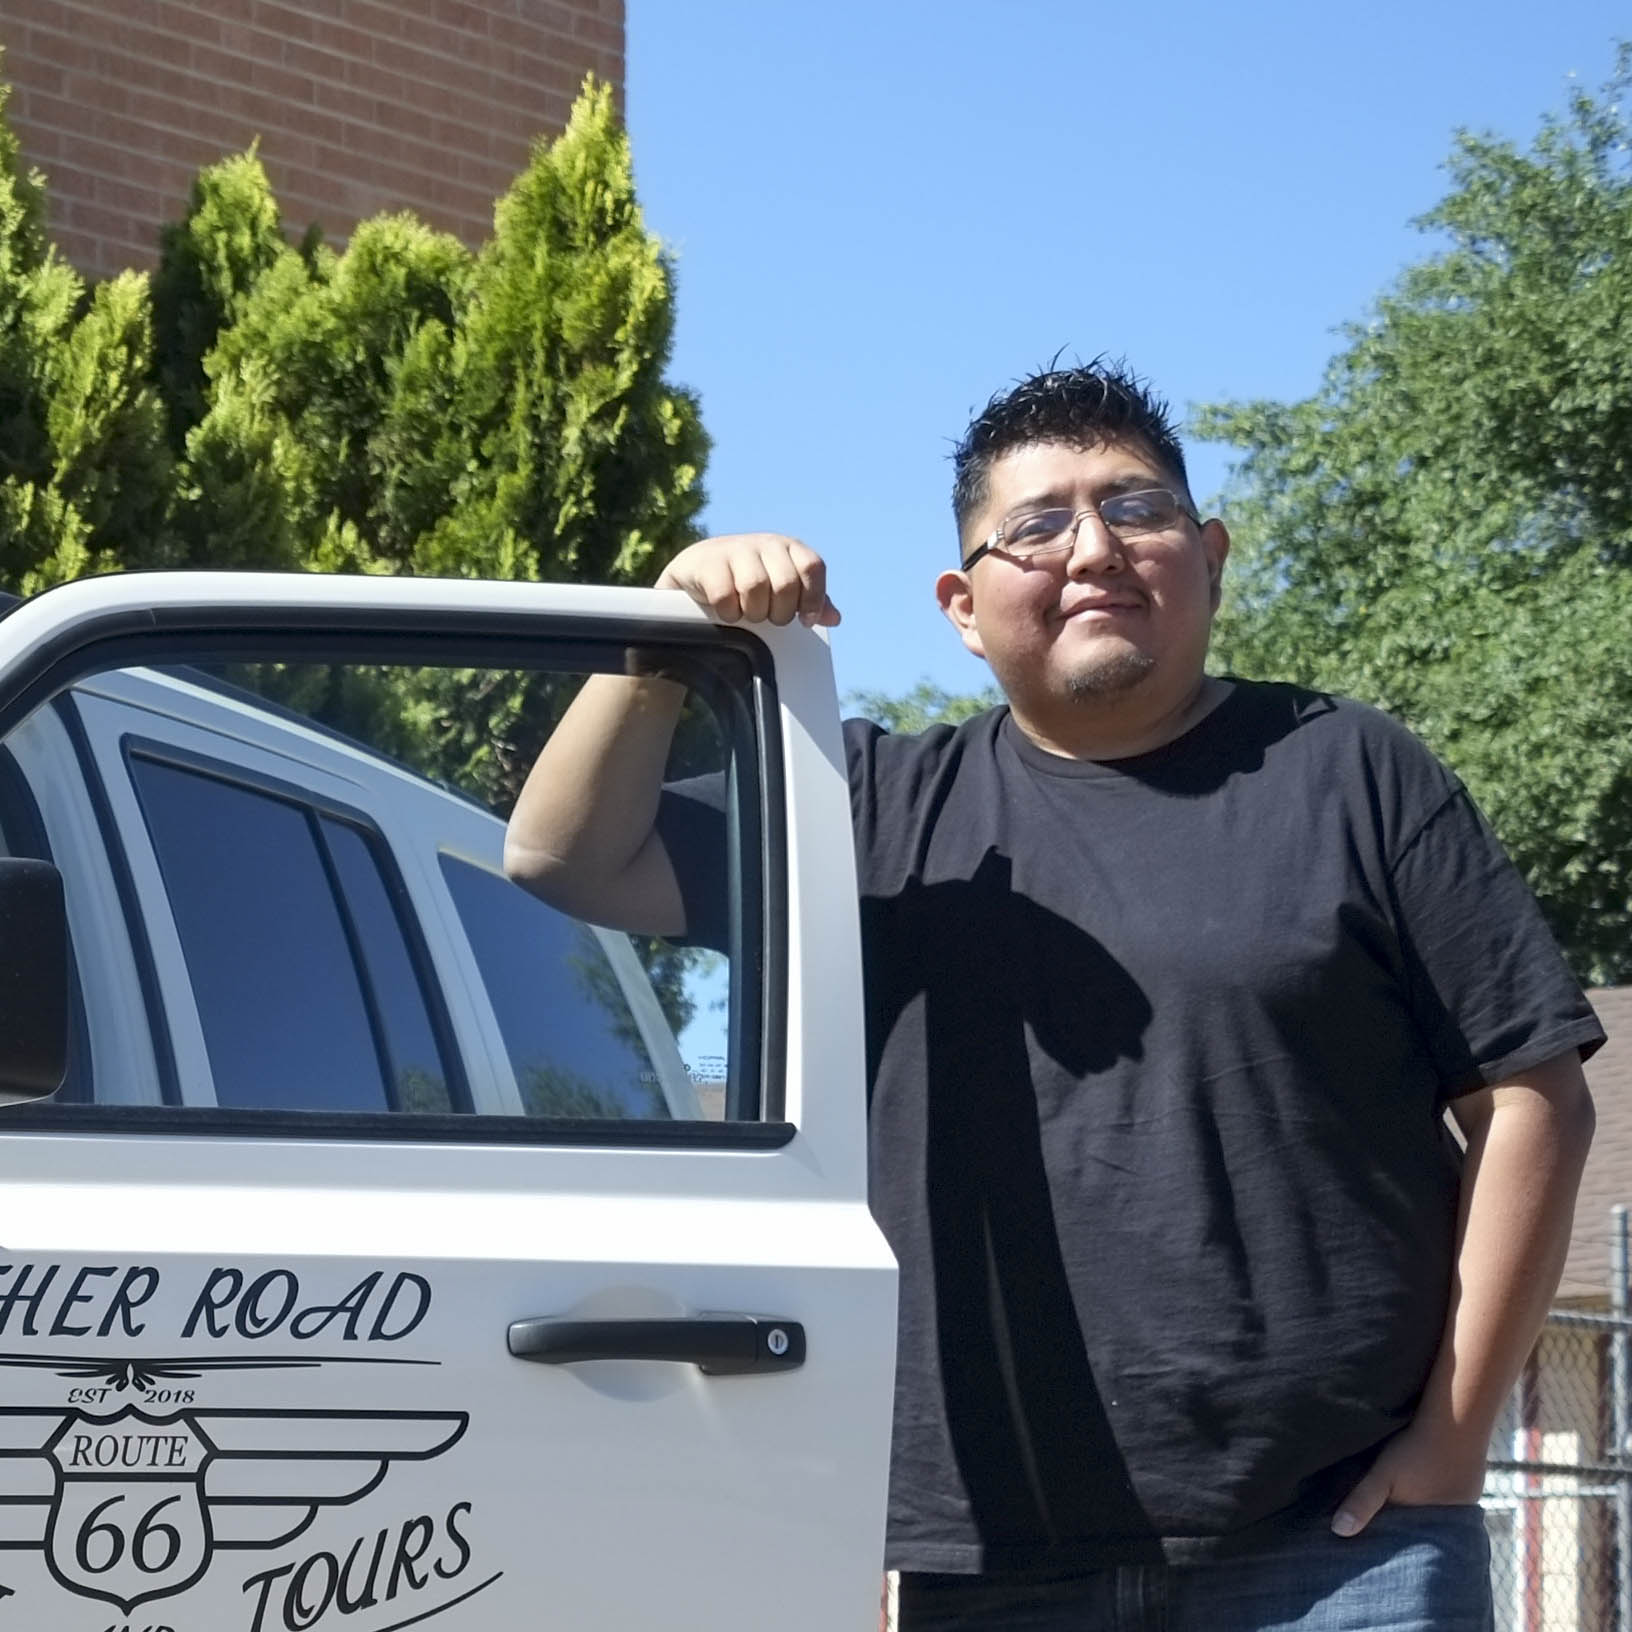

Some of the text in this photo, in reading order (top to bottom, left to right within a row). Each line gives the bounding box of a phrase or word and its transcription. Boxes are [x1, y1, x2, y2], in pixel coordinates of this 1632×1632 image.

[181, 1267, 432, 1341] ROAD
[67, 1387, 195, 1404] EST 2018
[68, 1434, 189, 1468] ROUTE
[75, 1494, 182, 1574] 66
